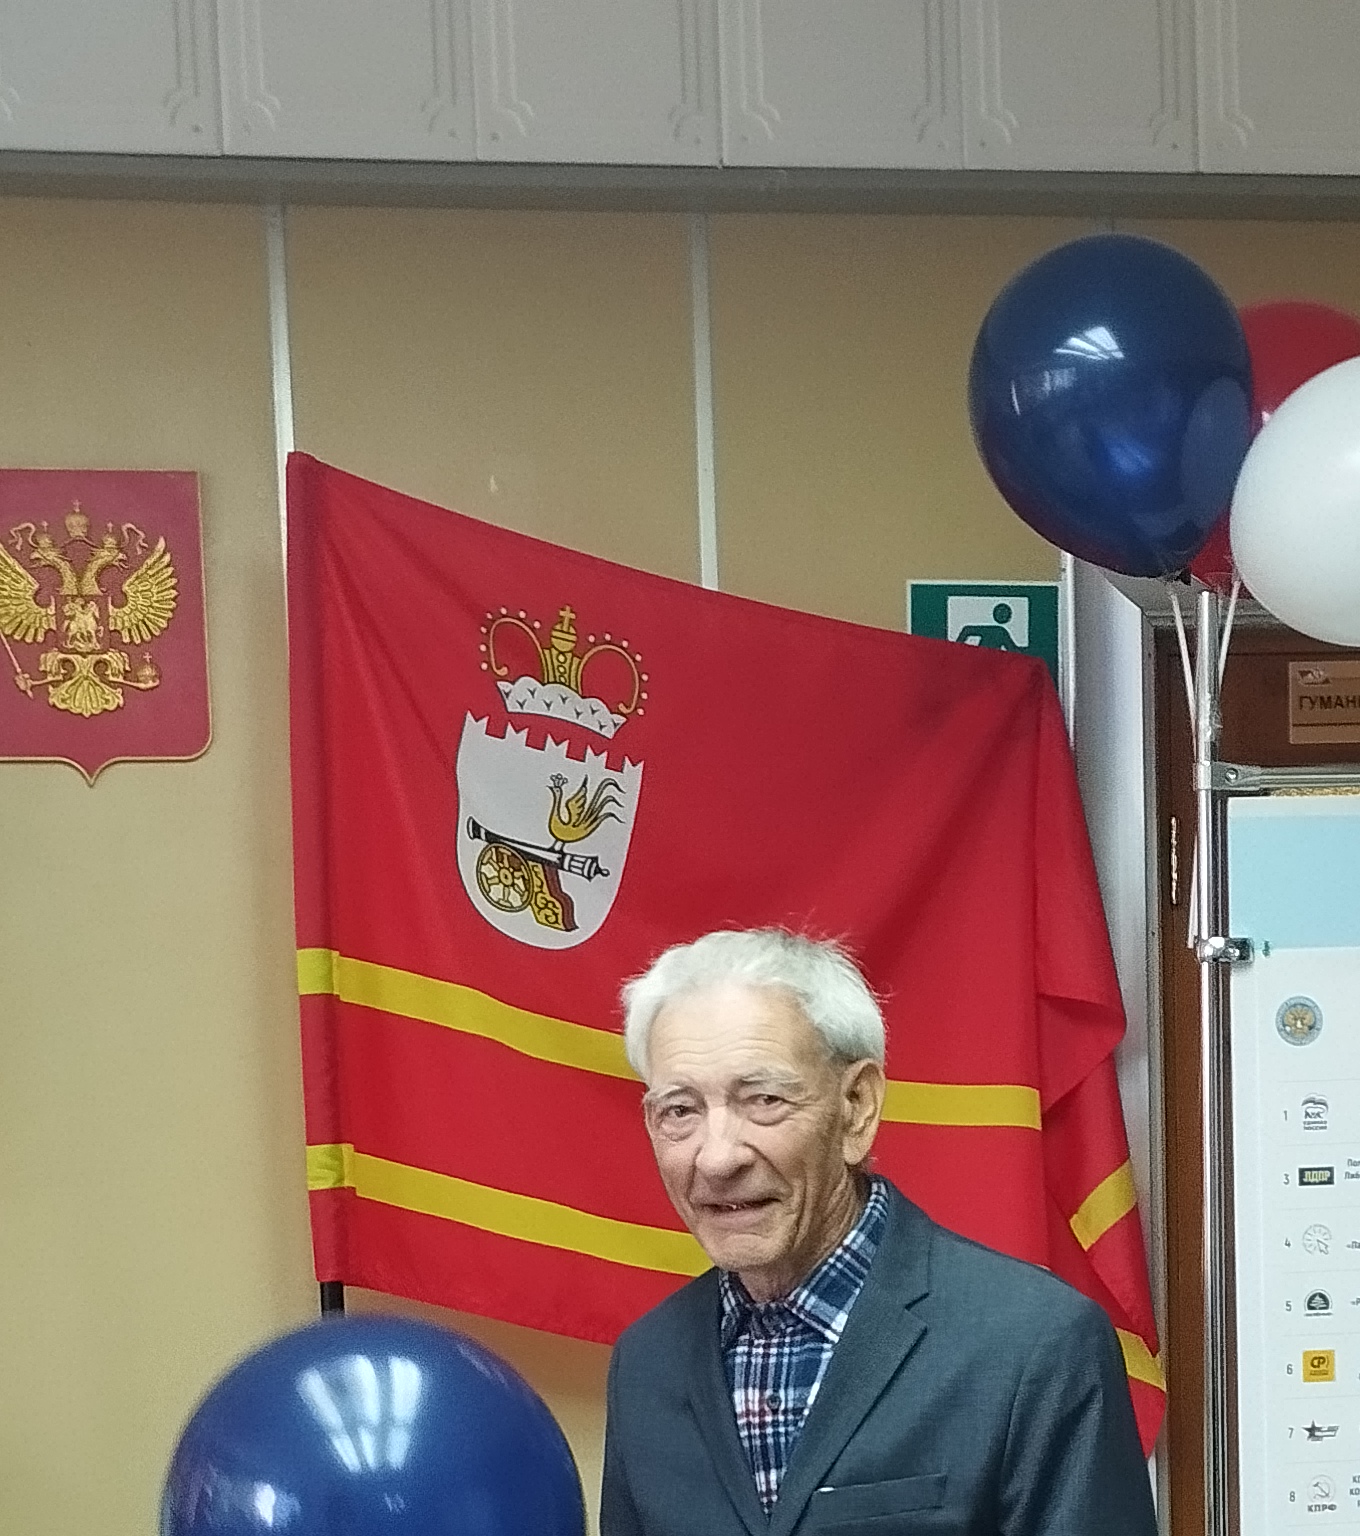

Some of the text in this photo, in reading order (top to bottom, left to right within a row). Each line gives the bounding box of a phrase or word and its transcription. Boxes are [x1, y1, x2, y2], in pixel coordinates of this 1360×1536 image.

[1283, 1110, 1288, 1121] 1
[1283, 1174, 1290, 1185] 3
[1284, 1238, 1291, 1248] 4
[1285, 1300, 1292, 1311] 5
[1286, 1364, 1293, 1375] 6
[1288, 1428, 1294, 1438] 7
[1289, 1491, 1296, 1502] 8
[1307, 1503, 1337, 1513] КПРФ
